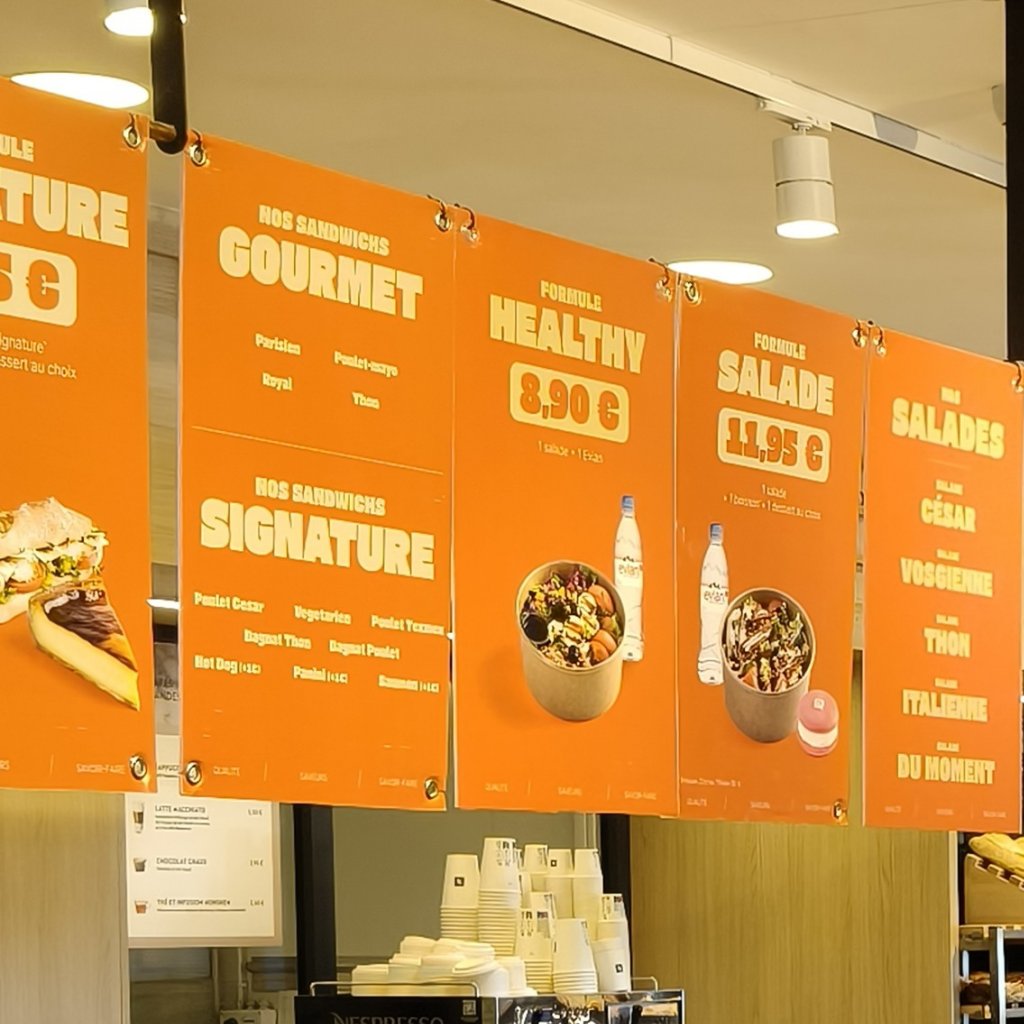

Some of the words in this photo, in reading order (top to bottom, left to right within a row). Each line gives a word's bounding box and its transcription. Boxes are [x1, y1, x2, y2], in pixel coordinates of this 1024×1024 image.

[0, 167, 129, 248] TURE
[259, 204, 293, 230] NOS
[296, 213, 390, 256] SANDWICHS
[219, 226, 423, 319] GOURMET
[540, 279, 603, 312] FORMULE
[489, 293, 646, 375] HEALTHY
[754, 332, 806, 361] FORMULE
[262, 372, 293, 391] Royal
[519, 371, 590, 426] 8,90
[717, 349, 834, 417] SALADE
[725, 417, 798, 467] 11,95
[892, 397, 1005, 460] SALADES
[255, 477, 289, 500] NOS
[292, 483, 386, 516] SANDWICHS
[921, 494, 976, 533] CÉSAR
[200, 498, 435, 581] SIGNATURE
[900, 556, 993, 598] VOSGIENNE
[924, 627, 970, 658] THON
[902, 688, 988, 723] ITALIENNE
[897, 753, 921, 780] DU
[925, 756, 996, 785] MOMENT
